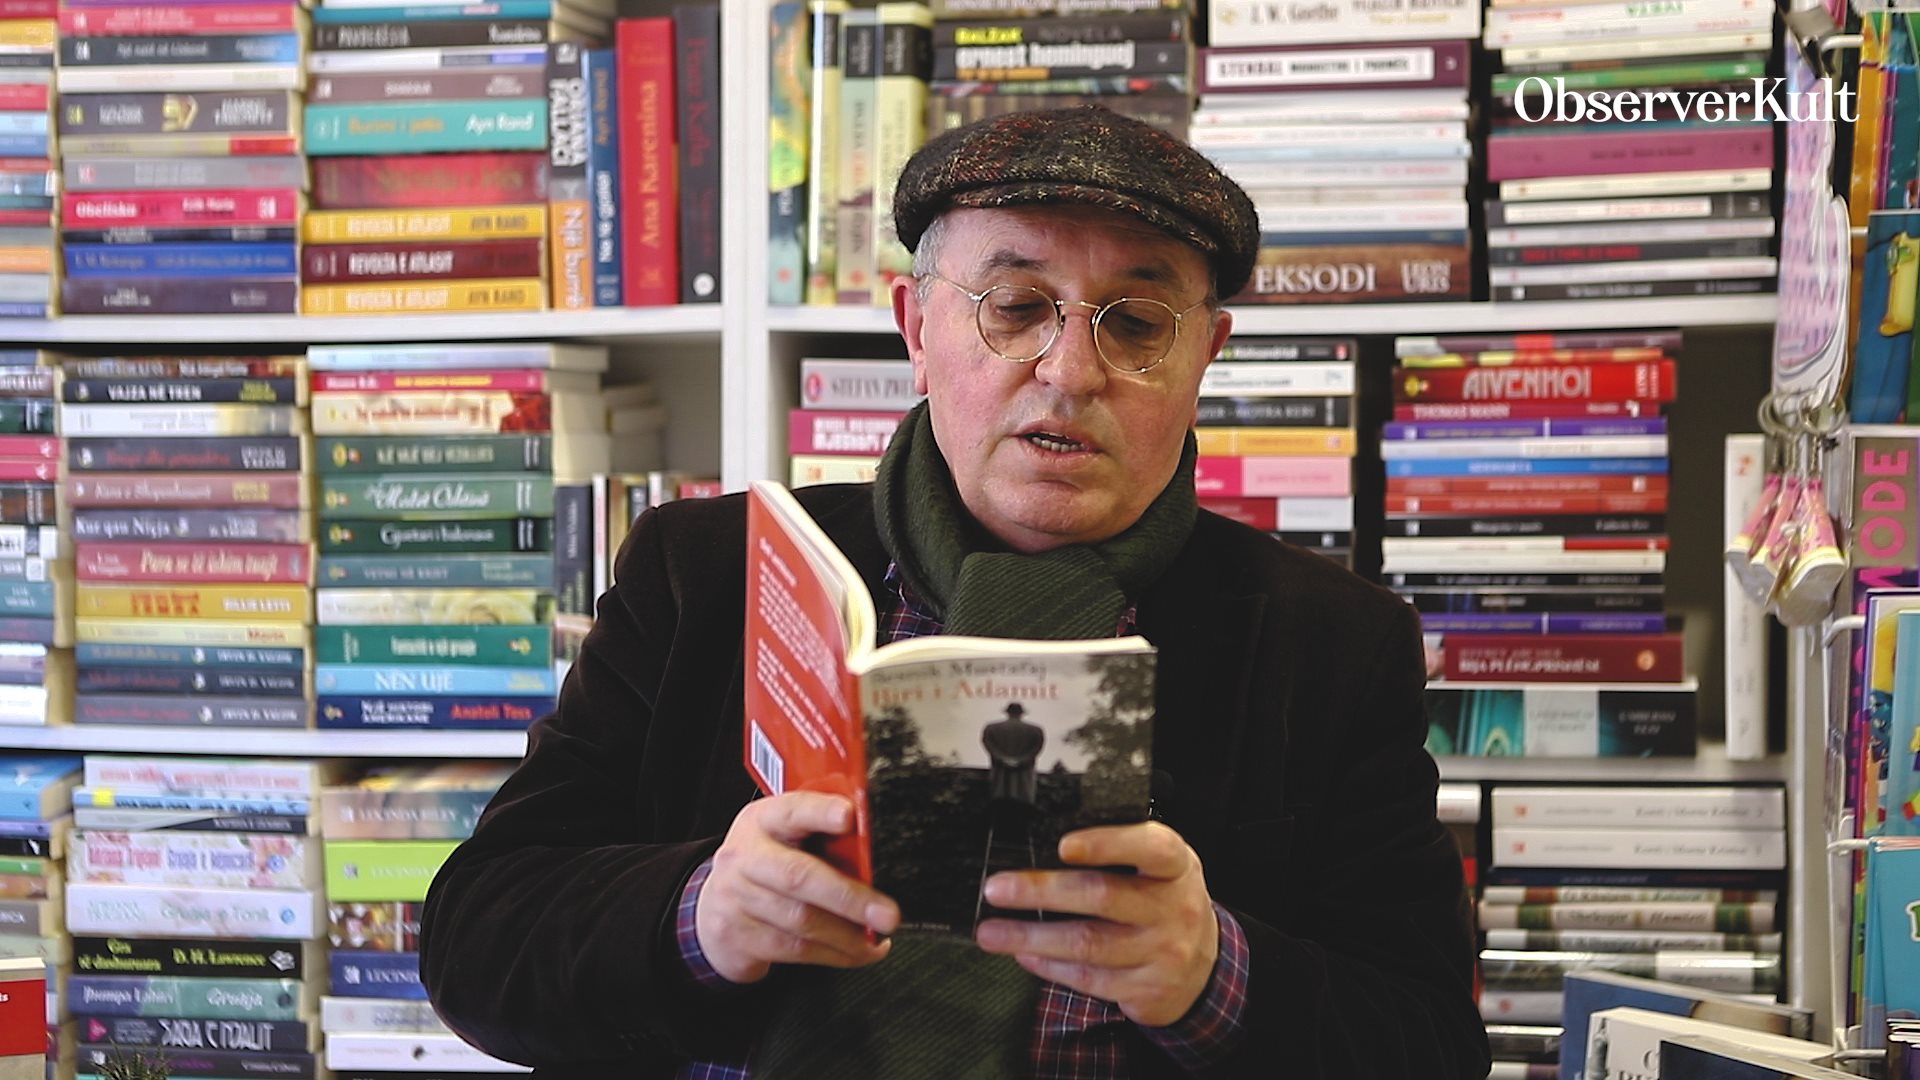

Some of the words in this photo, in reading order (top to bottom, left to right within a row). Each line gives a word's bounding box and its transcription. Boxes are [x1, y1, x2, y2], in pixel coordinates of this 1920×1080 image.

[466, 115, 493, 135] Ayn
[496, 112, 534, 132] Rand
[637, 79, 660, 194] Karenina
[641, 198, 661, 249] Ana
[349, 253, 396, 274] REVOLTA
[409, 251, 454, 272] ATLASIT
[1256, 263, 1376, 293] EKSODI
[108, 385, 148, 401] VAJZA
[168, 384, 202, 401] TREN
[832, 377, 879, 394] STEFAN
[75, 518, 100, 536] Kur
[375, 670, 418, 690] NËN
[952, 679, 1060, 700] Adamit
[210, 950, 267, 967] Lawrence
